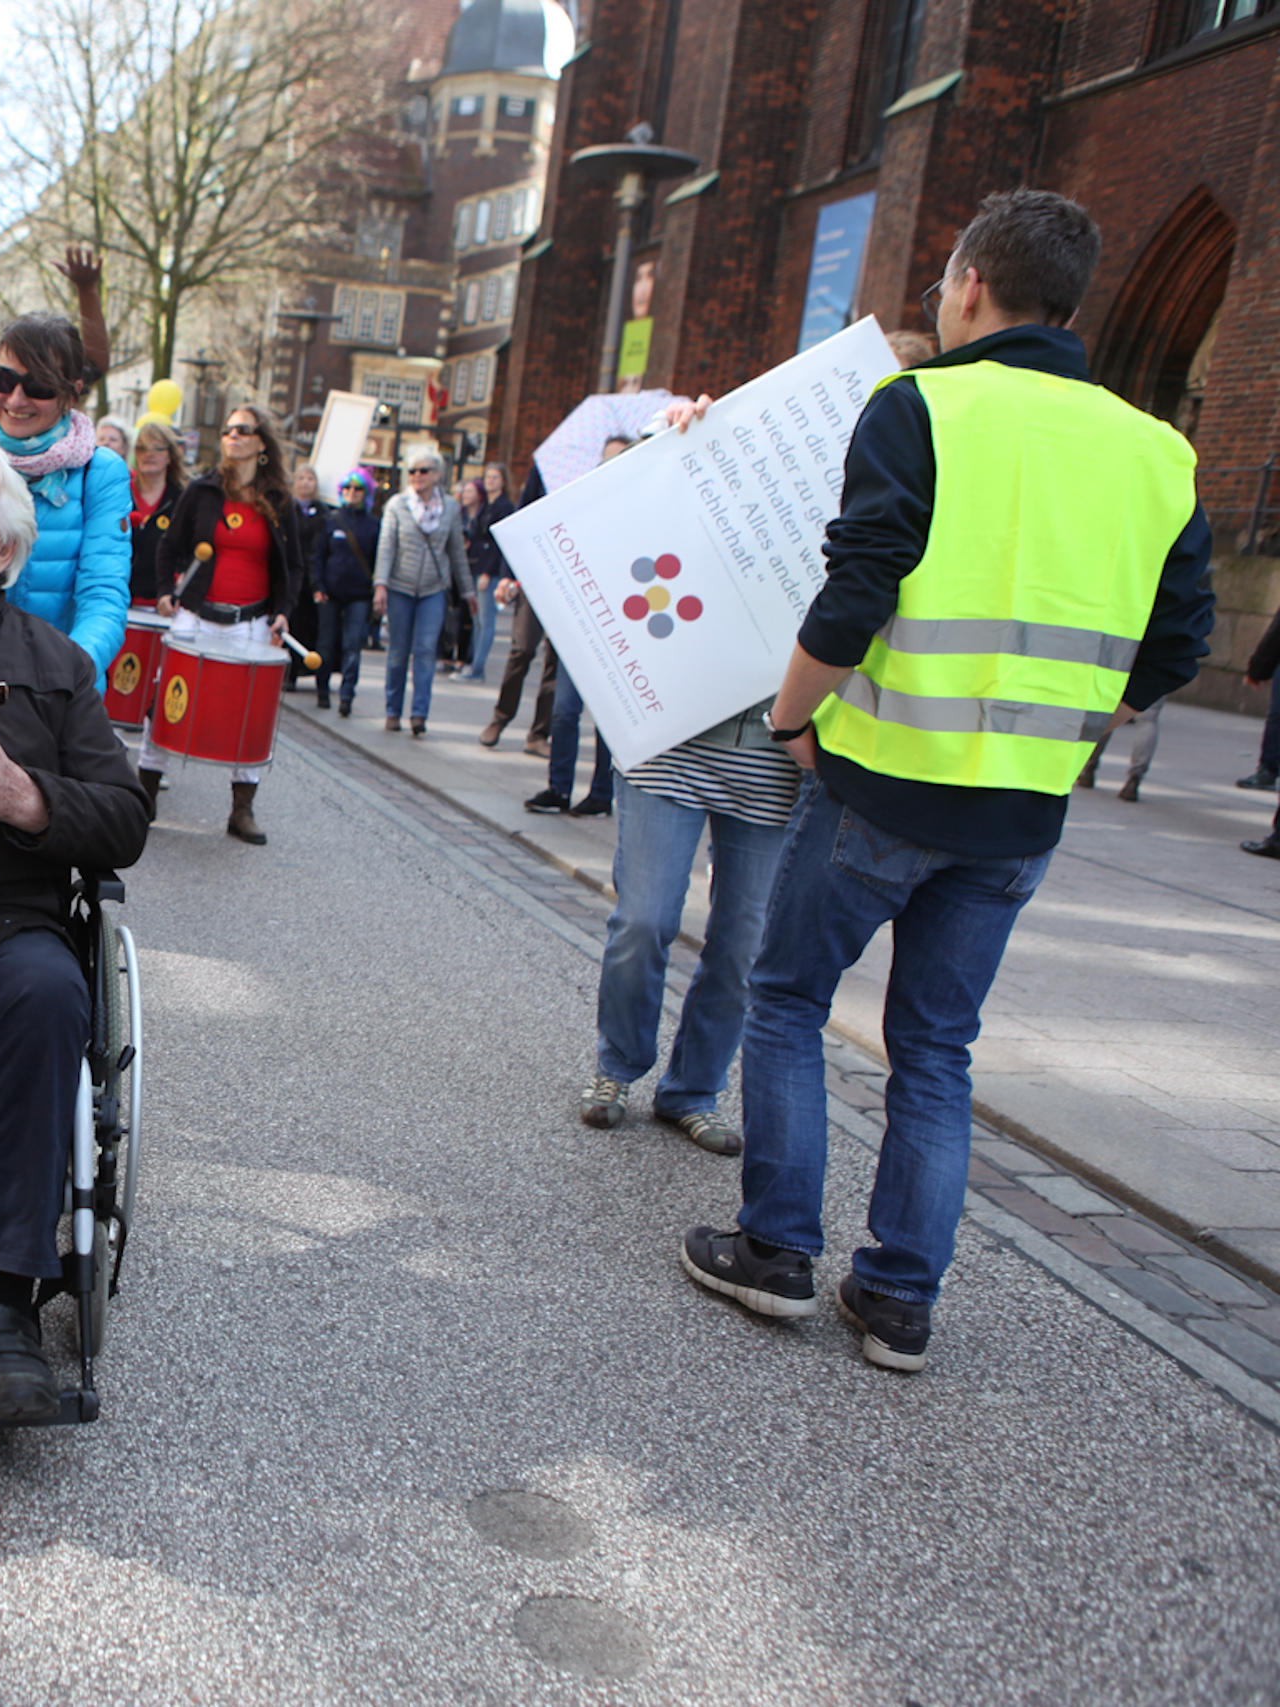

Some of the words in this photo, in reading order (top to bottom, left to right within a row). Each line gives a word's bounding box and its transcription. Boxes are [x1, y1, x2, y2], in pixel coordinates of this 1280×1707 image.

[784, 395, 809, 431] um
[805, 433, 828, 465] die
[811, 381, 842, 428] man
[681, 451, 703, 478] ist
[706, 439, 742, 498] sollte.
[740, 503, 774, 551] Alles
[732, 425, 756, 456] die
[751, 456, 802, 544] behalten
[759, 407, 801, 473] wieder
[794, 478, 814, 502] zu
[804, 506, 828, 539] ge
[533, 534, 557, 576] Demenz
[556, 576, 580, 619] berührt
[578, 617, 592, 638] mit
[588, 637, 608, 671] vielen
[607, 670, 640, 727] Gesichtern
[549, 522, 616, 628] KONFETTI
[608, 631, 630, 657] IM
[624, 660, 664, 714] KOPF
